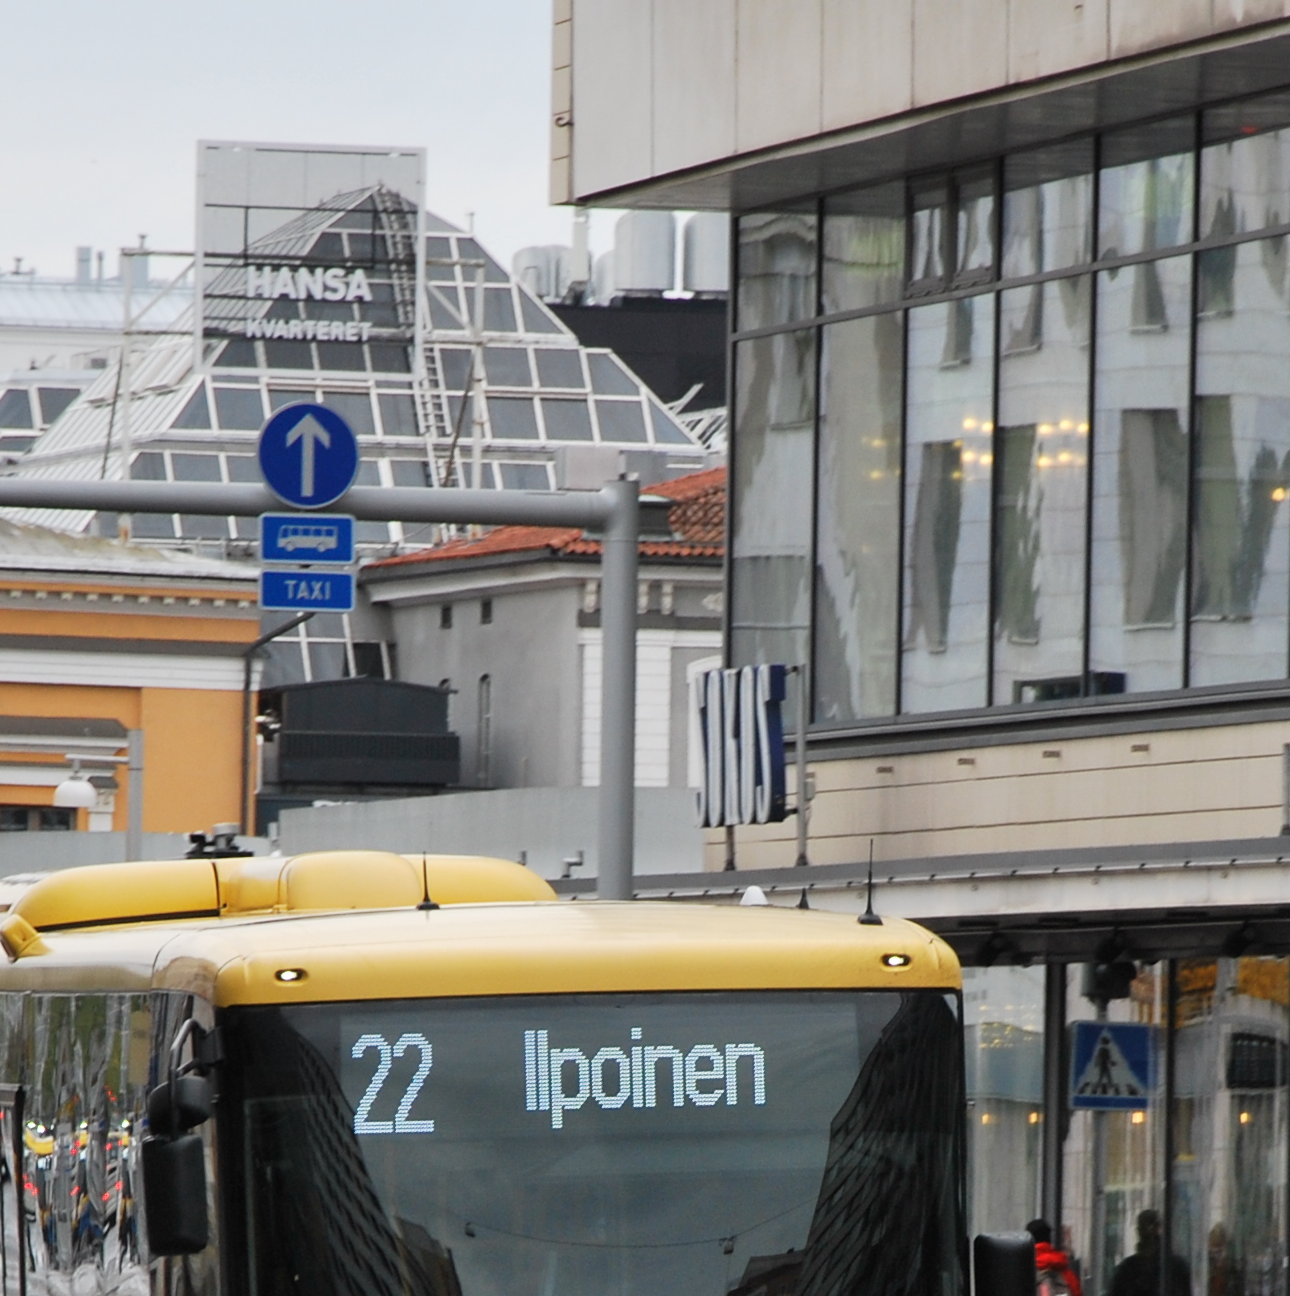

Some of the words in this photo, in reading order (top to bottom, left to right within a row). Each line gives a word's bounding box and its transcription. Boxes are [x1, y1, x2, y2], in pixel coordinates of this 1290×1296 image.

[246, 265, 373, 302] HANSA
[245, 318, 372, 342] KVARTERET
[283, 579, 332, 600] TAXI
[352, 1033, 435, 1135] 22
[524, 1027, 766, 1129] Ilpoinen
